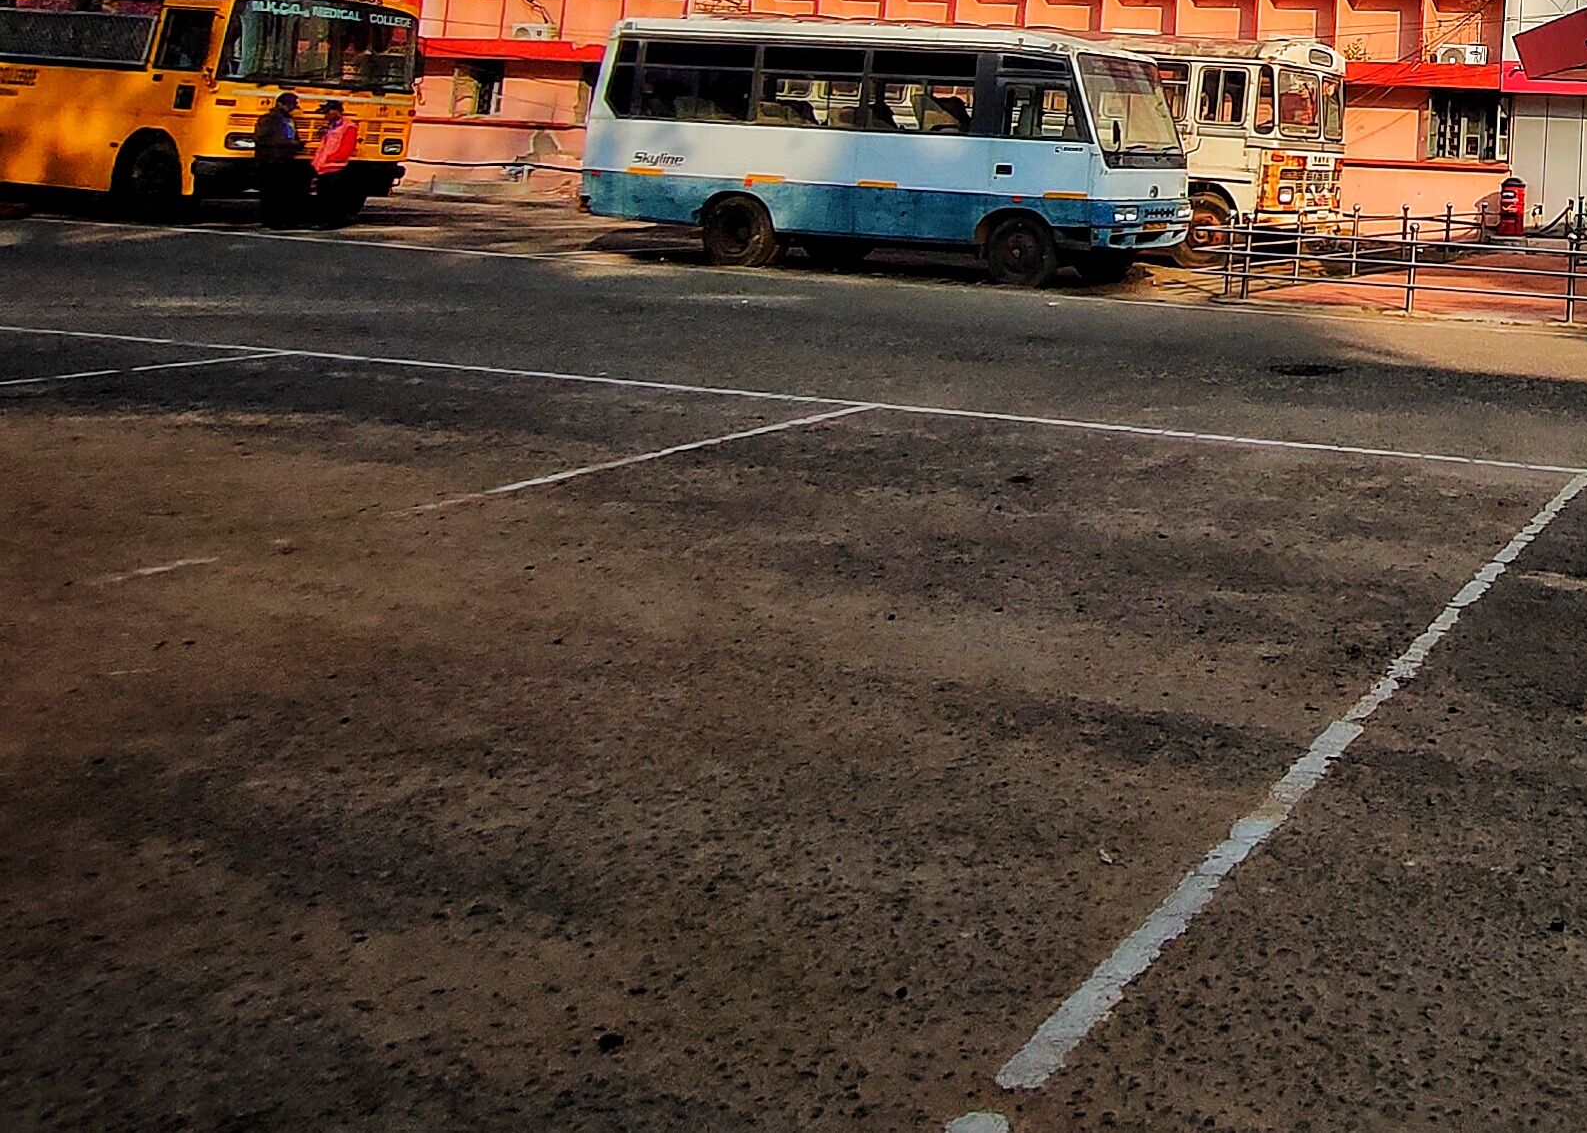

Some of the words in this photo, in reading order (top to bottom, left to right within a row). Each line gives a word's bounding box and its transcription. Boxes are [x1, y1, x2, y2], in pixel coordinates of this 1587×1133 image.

[312, 5, 362, 21] MEDICAL
[369, 13, 412, 29] COLLEGE
[632, 151, 685, 167] Skyline
